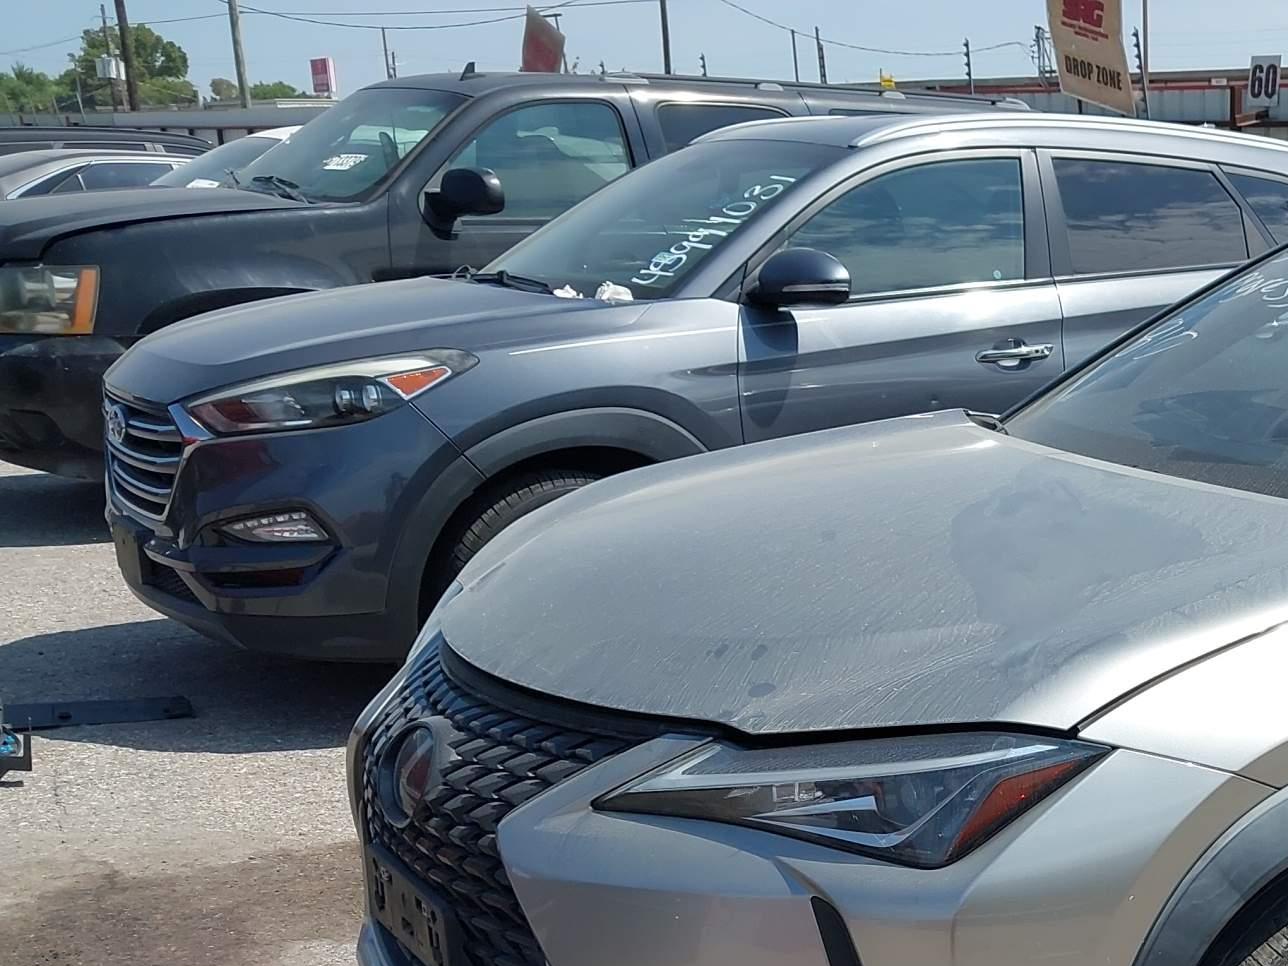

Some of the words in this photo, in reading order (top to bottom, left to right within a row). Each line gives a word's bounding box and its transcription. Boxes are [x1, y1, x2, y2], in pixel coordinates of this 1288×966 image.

[1064, 55, 1093, 80] DROP
[1096, 65, 1122, 91] ZONE
[1250, 65, 1278, 99] 60
